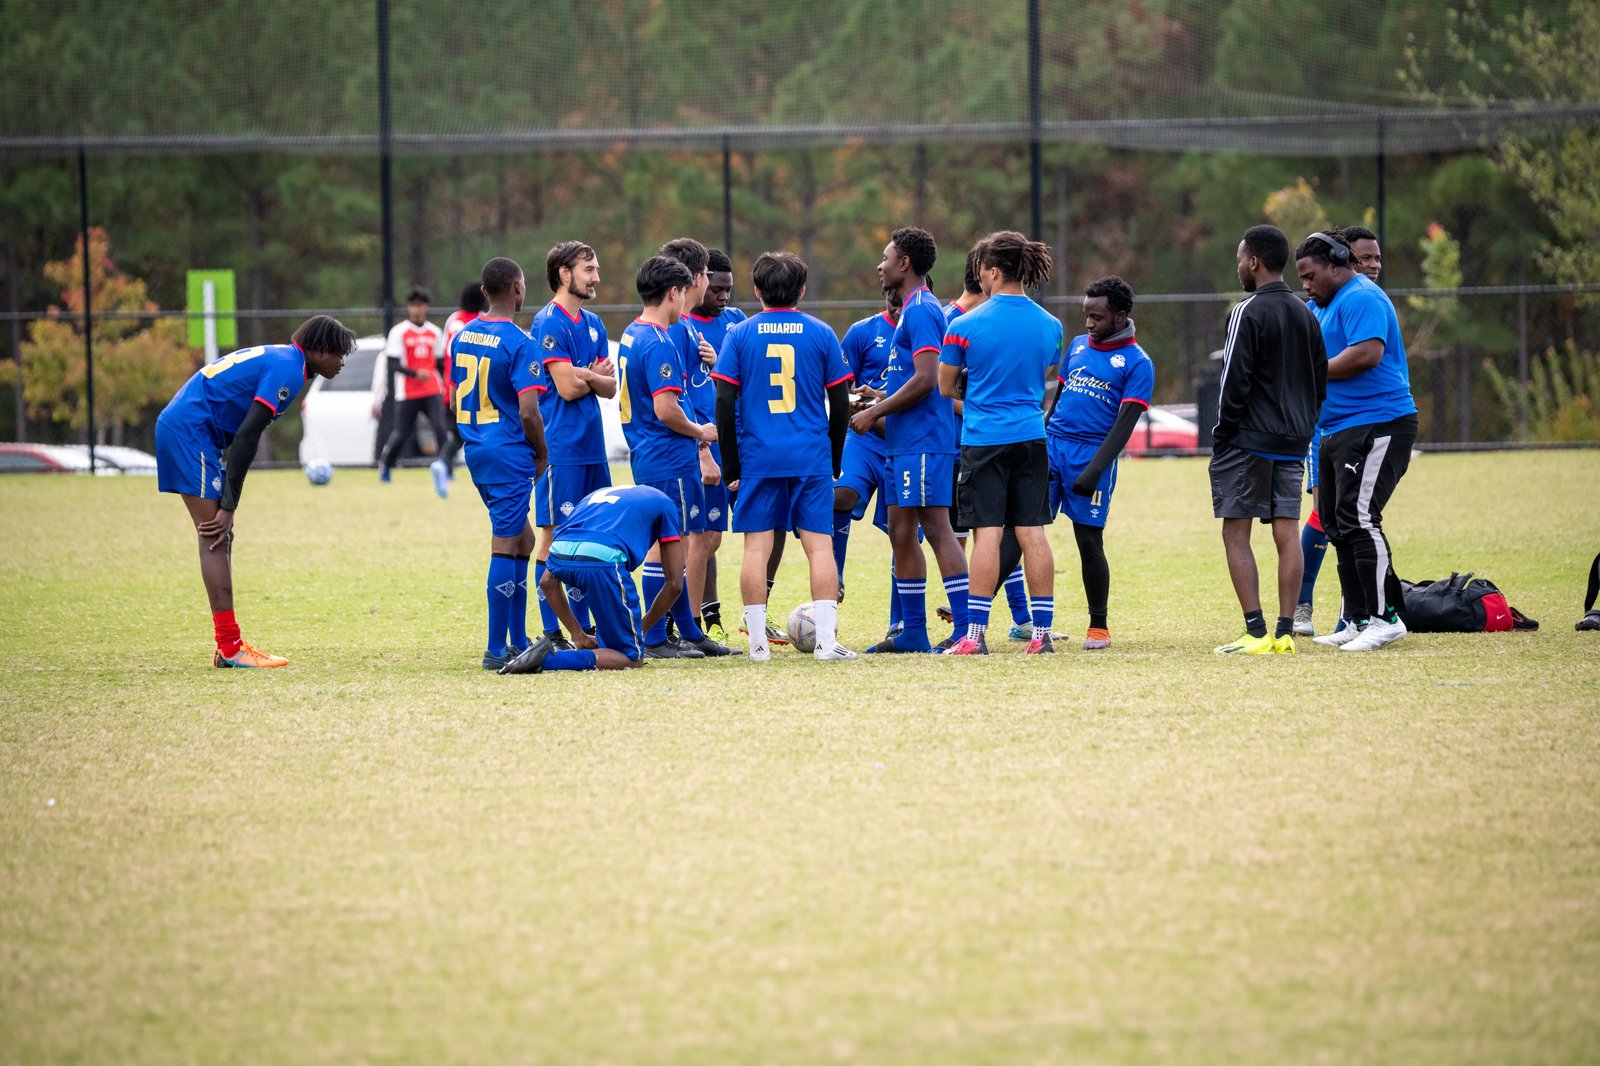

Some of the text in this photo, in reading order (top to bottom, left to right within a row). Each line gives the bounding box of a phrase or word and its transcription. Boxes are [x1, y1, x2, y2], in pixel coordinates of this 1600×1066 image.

[758, 322, 804, 335] EDUARDO
[766, 343, 797, 414] 3
[455, 352, 500, 425] 21
[1068, 385, 1112, 404] FOOTBALL
[903, 470, 911, 487] 5
[1090, 489, 1102, 507] 11
